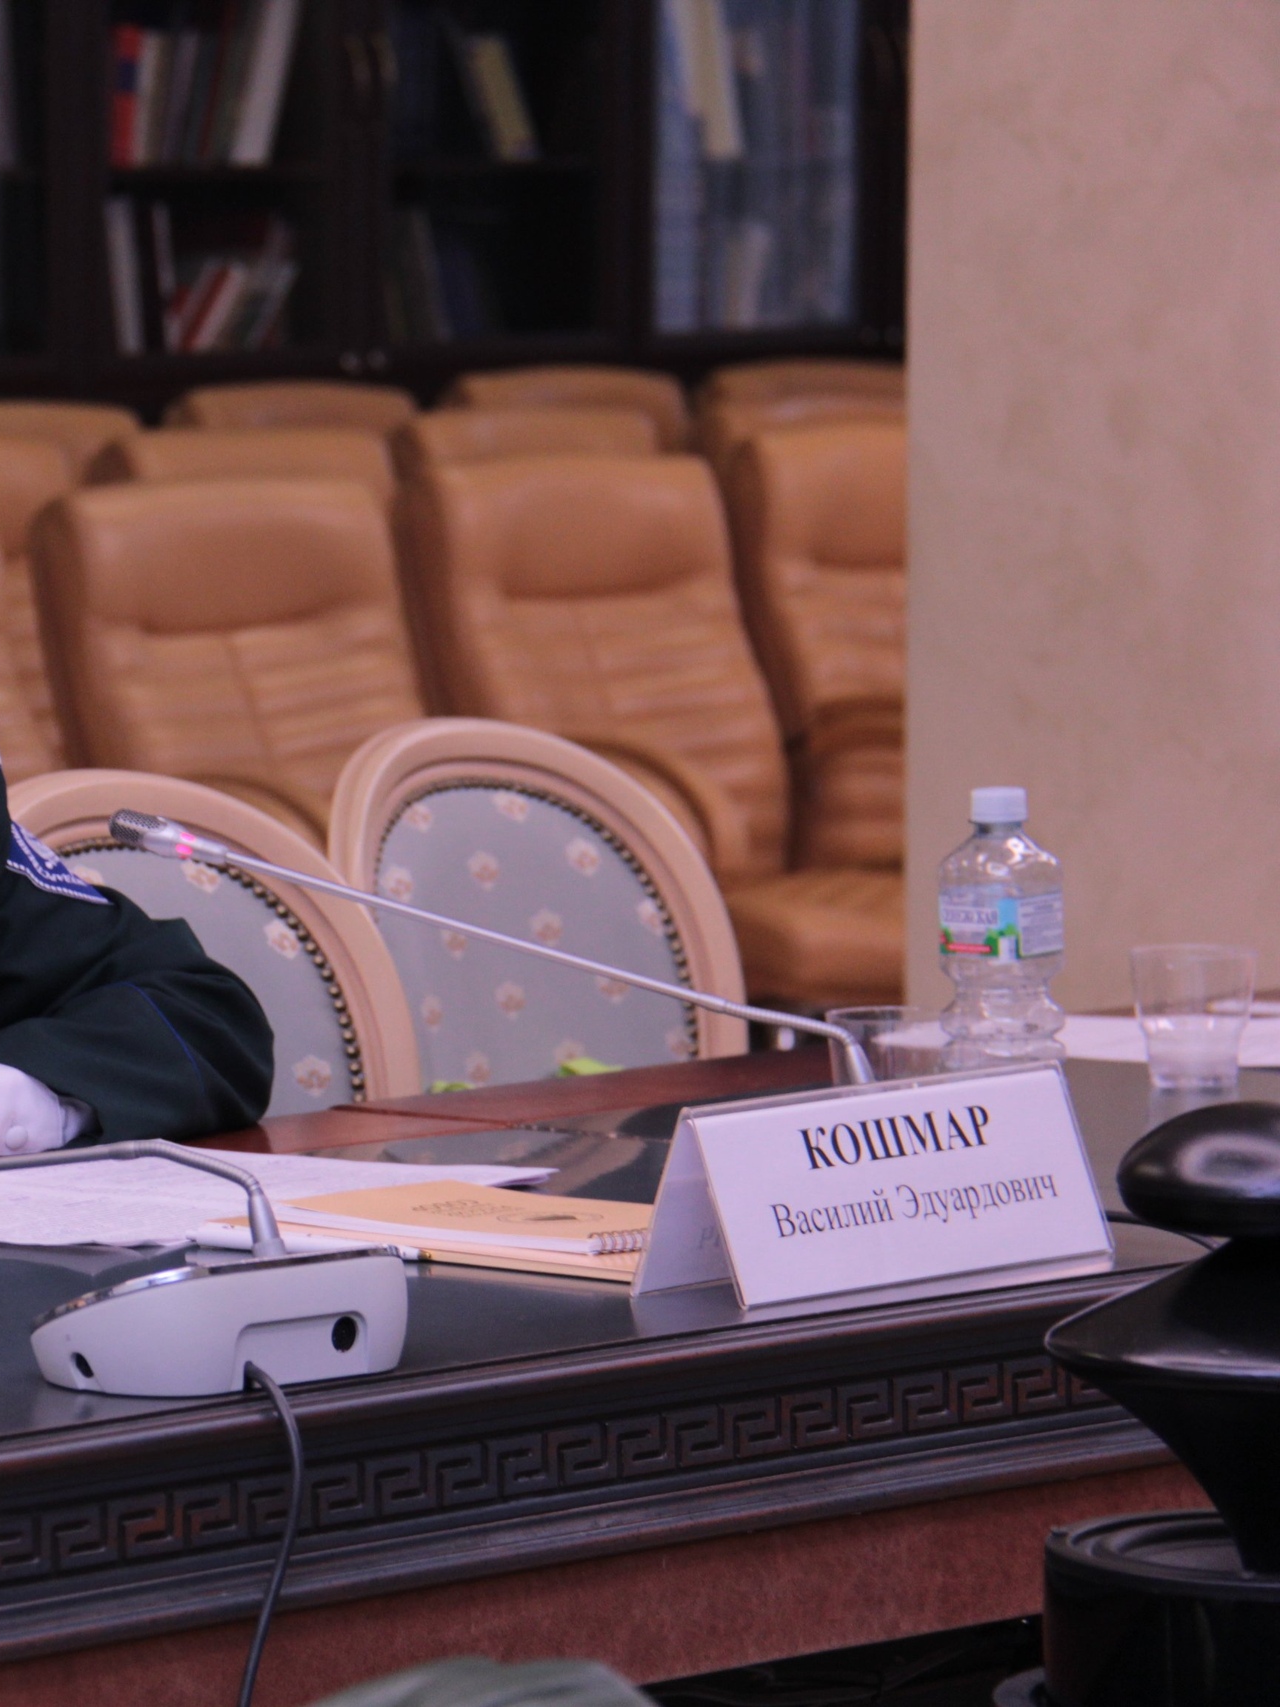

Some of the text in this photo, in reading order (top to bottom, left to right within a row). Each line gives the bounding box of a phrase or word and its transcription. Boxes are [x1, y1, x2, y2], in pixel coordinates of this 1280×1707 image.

[798, 1105, 990, 1170] КОШМАР
[771, 1189, 894, 1238] Василий
[896, 1174, 1058, 1223] Эдуардович
